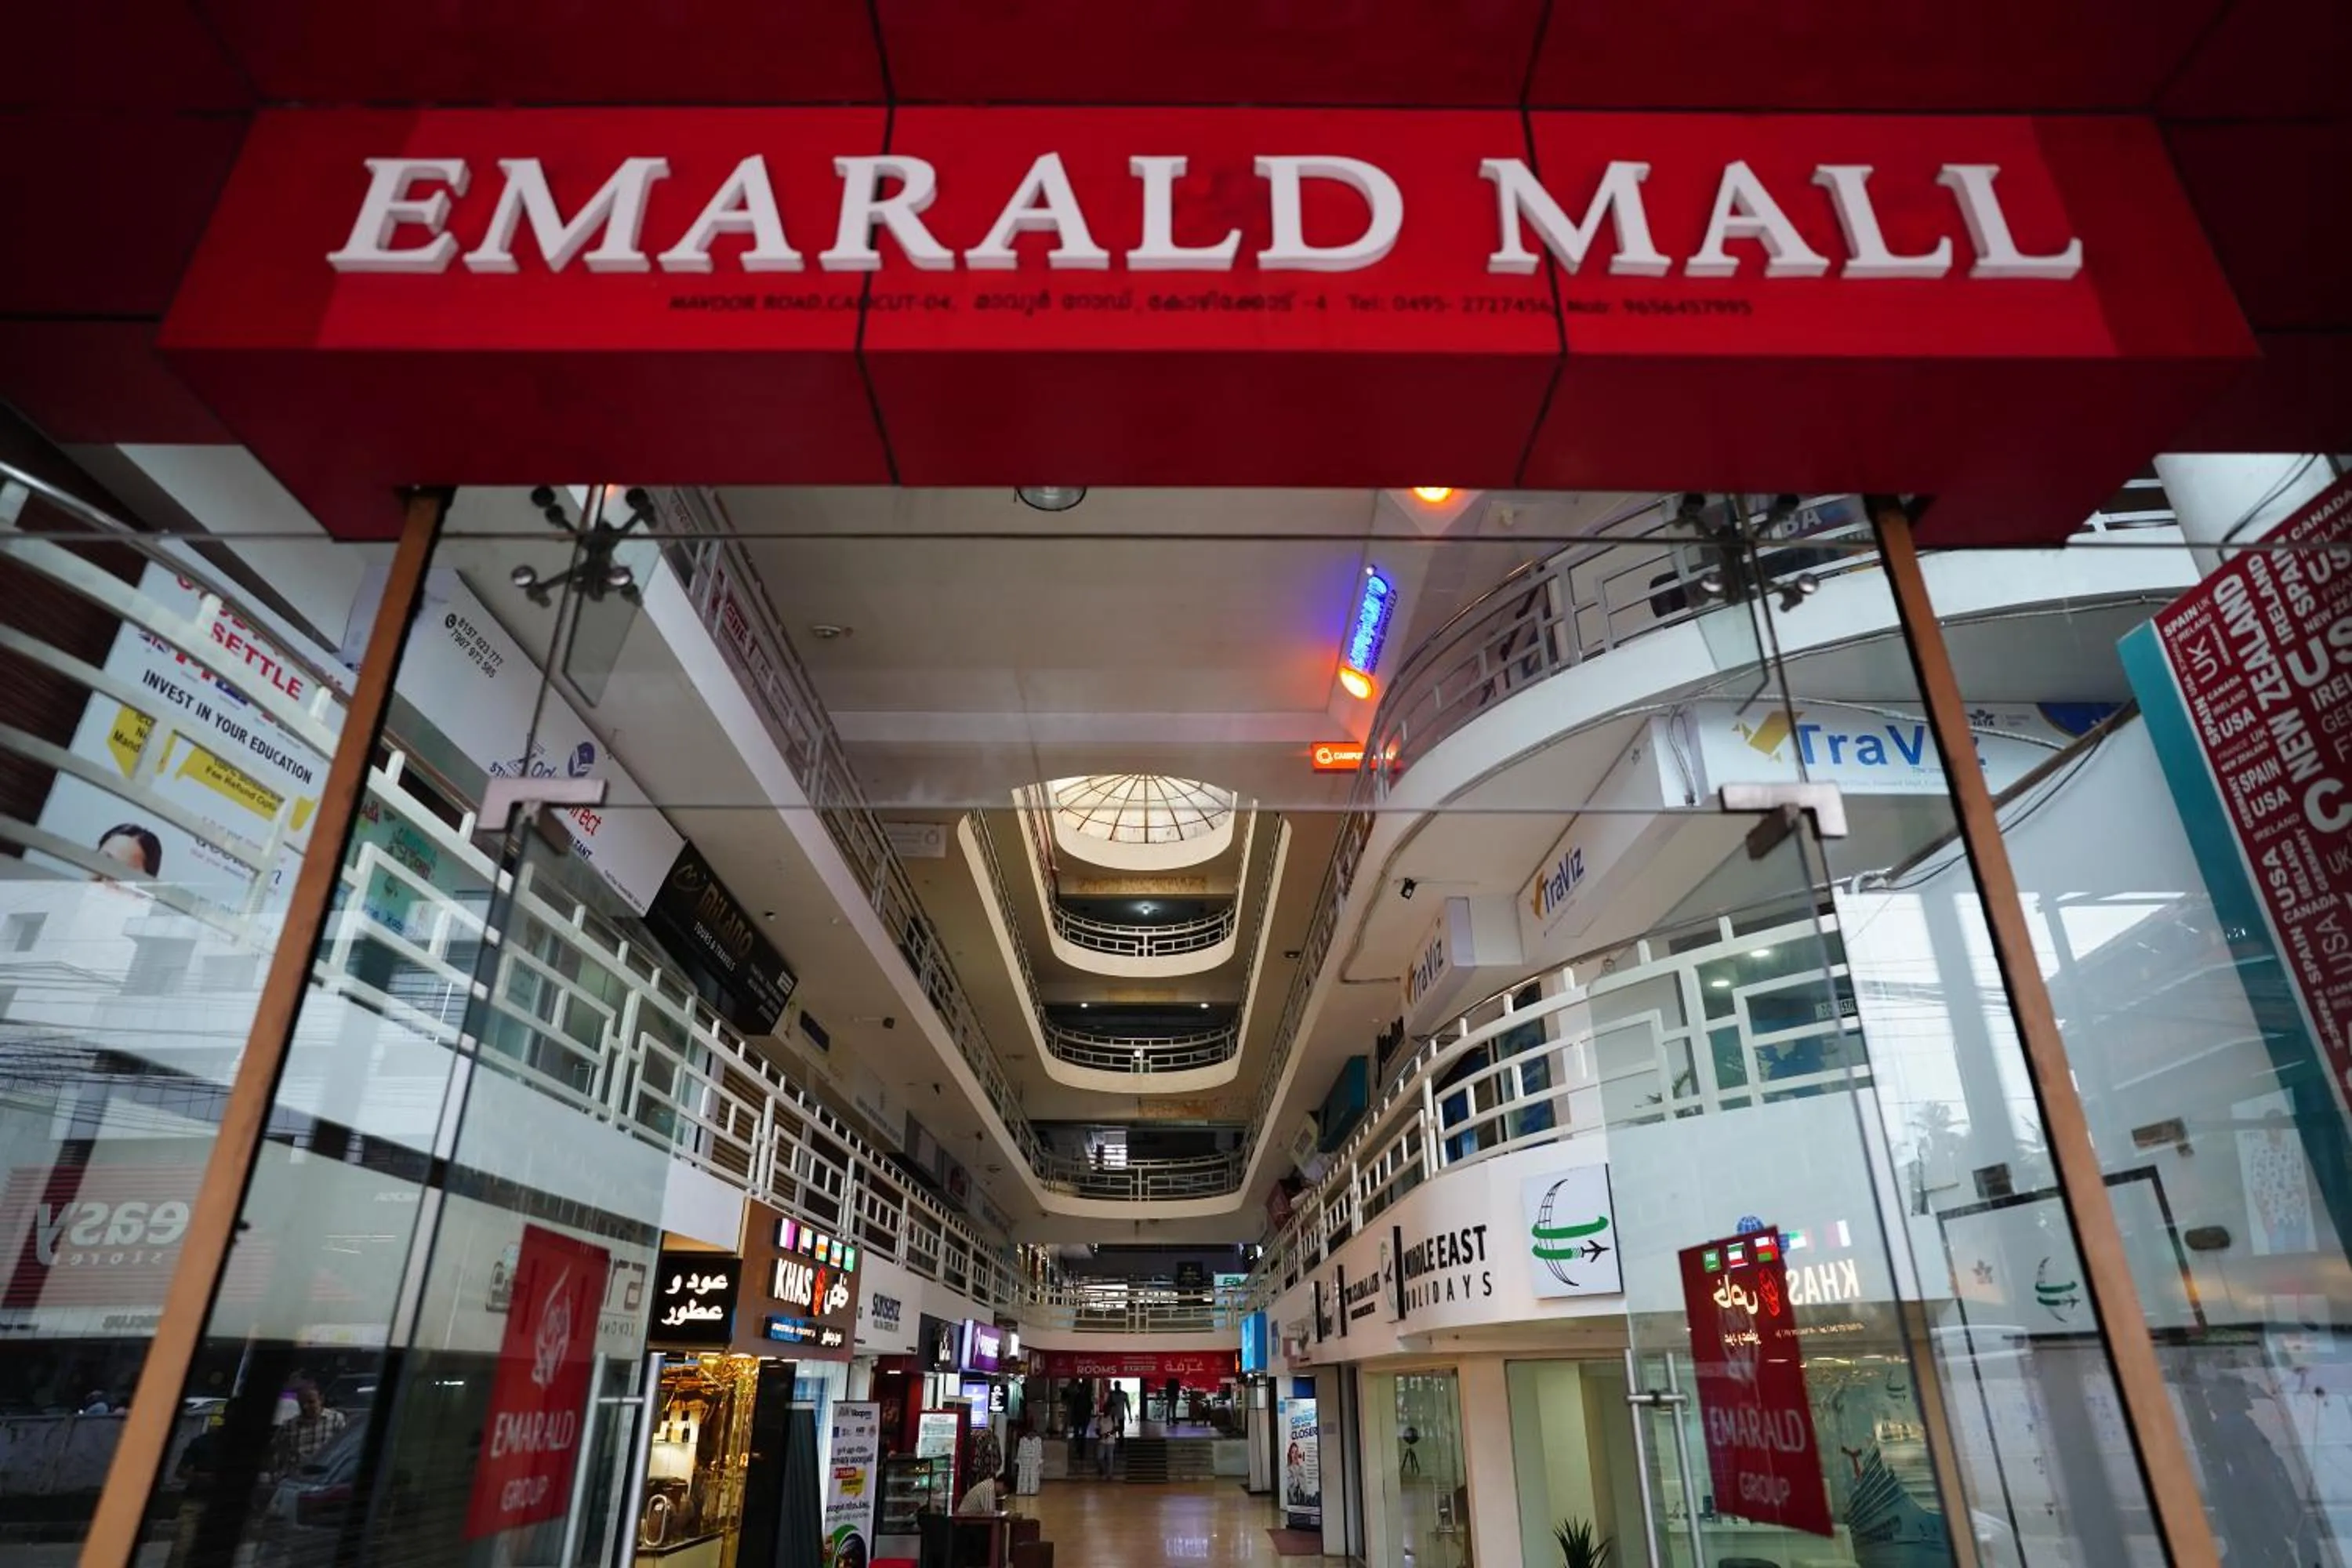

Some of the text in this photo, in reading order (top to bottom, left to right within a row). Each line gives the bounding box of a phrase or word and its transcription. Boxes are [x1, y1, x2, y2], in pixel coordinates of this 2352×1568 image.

[326, 151, 2083, 279] EMARALD MALL
[211, 621, 303, 701] SETTLE
[2186, 636, 2219, 684] UK
[2213, 572, 2292, 712] ZEALAND
[142, 669, 194, 710] INVEST
[195, 701, 212, 723] IN
[215, 712, 247, 744] YOUR
[249, 734, 314, 785] EDUCATION
[2219, 706, 2257, 739] USA
[2238, 756, 2283, 793] SPAIN
[2250, 786, 2292, 818] USA
[1541, 846, 1585, 916] TraViz
[2262, 846, 2296, 909] USA
[2282, 892, 2341, 926] CANADA
[1410, 938, 1444, 1004] TraViz
[2291, 927, 2324, 986] SPAIN
[1437, 1225, 1488, 1270] EAST
[664, 1271, 729, 1295] عود و
[775, 1258, 813, 1307] KHAS
[660, 1298, 725, 1327] عطور
[1076, 1364, 1117, 1375] ROOMS
[489, 1409, 575, 1460] EMARALD
[1708, 1406, 1806, 1454] EMARALD
[501, 1481, 550, 1514] GROUP
[1738, 1470, 1791, 1507] GROUP
